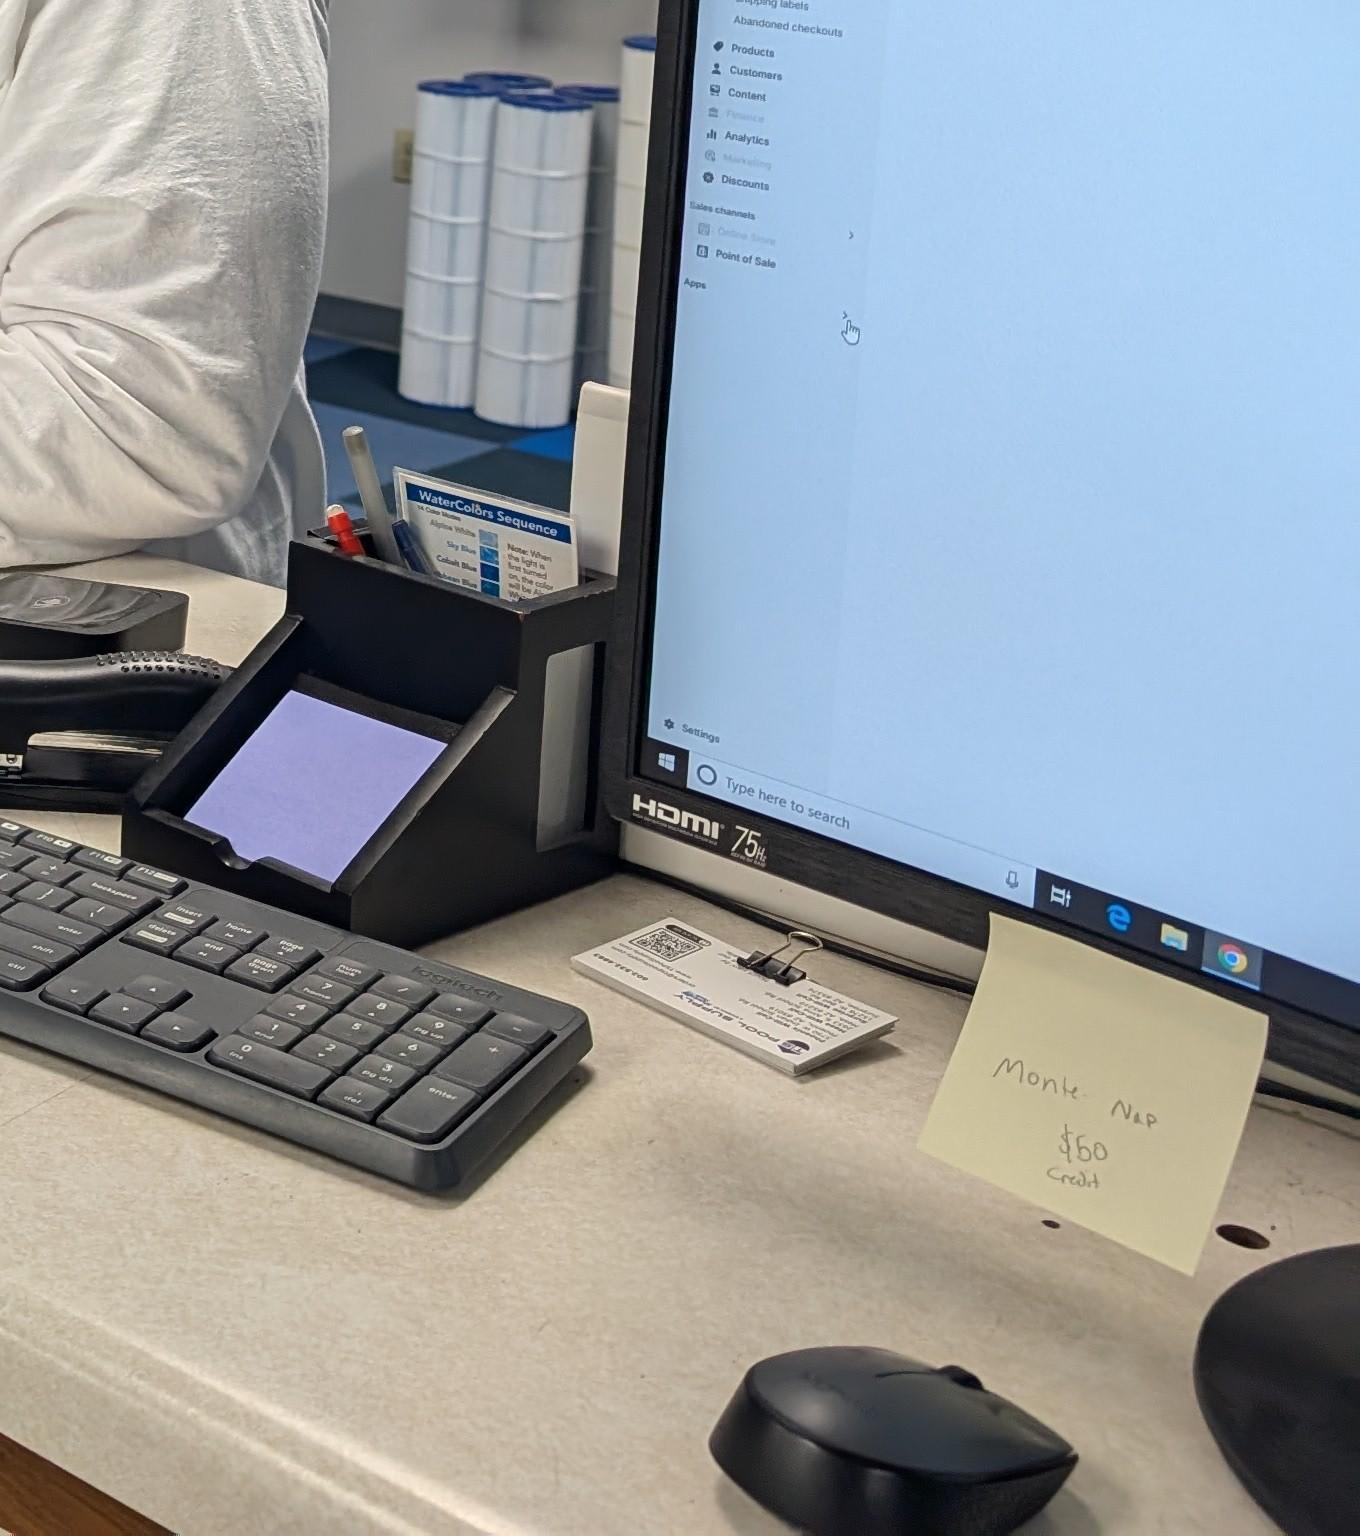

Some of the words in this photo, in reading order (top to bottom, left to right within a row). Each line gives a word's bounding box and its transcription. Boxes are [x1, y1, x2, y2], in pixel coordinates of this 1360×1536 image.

[734, 16, 789, 31] Abandoned
[792, 24, 843, 38] checkouts
[731, 44, 775, 58] Products
[730, 66, 783, 81] Customers
[728, 88, 767, 102] Content
[725, 131, 770, 146] Analytics
[721, 175, 770, 191] Discounts
[716, 249, 740, 263] Point
[742, 254, 752, 264] of
[755, 257, 776, 268] Sale
[684, 278, 706, 290] Apps
[418, 489, 494, 519] WaterColors
[497, 511, 558, 537] Sequence
[455, 525, 476, 538] White
[447, 541, 459, 552] Sky
[461, 544, 476, 555] Blue
[508, 553, 520, 564] the
[530, 549, 552, 562] When
[436, 555, 460, 568] Cobalt
[461, 561, 477, 573] Blue
[461, 577, 477, 589] Blue
[522, 575, 533, 586] the
[682, 724, 720, 744] Settings
[726, 776, 754, 797] Type
[759, 787, 787, 807] here
[791, 800, 804, 813] to
[808, 806, 850, 830] search
[632, 793, 720, 840] HDMI
[91, 881, 137, 900] backspace
[176, 905, 203, 918] insert
[56, 923, 83, 935] enter
[148, 923, 176, 937] delete
[226, 922, 253, 935] home
[31, 944, 55, 954] shift
[204, 942, 223, 952] end
[280, 939, 303, 950] page
[247, 964, 275, 974] down
[253, 957, 278, 968] page
[338, 963, 362, 974] num
[413, 964, 505, 1003] logitech
[672, 992, 735, 1021] SUPPLY
[733, 1020, 781, 1042] POOL
[429, 1086, 458, 1100] enter
